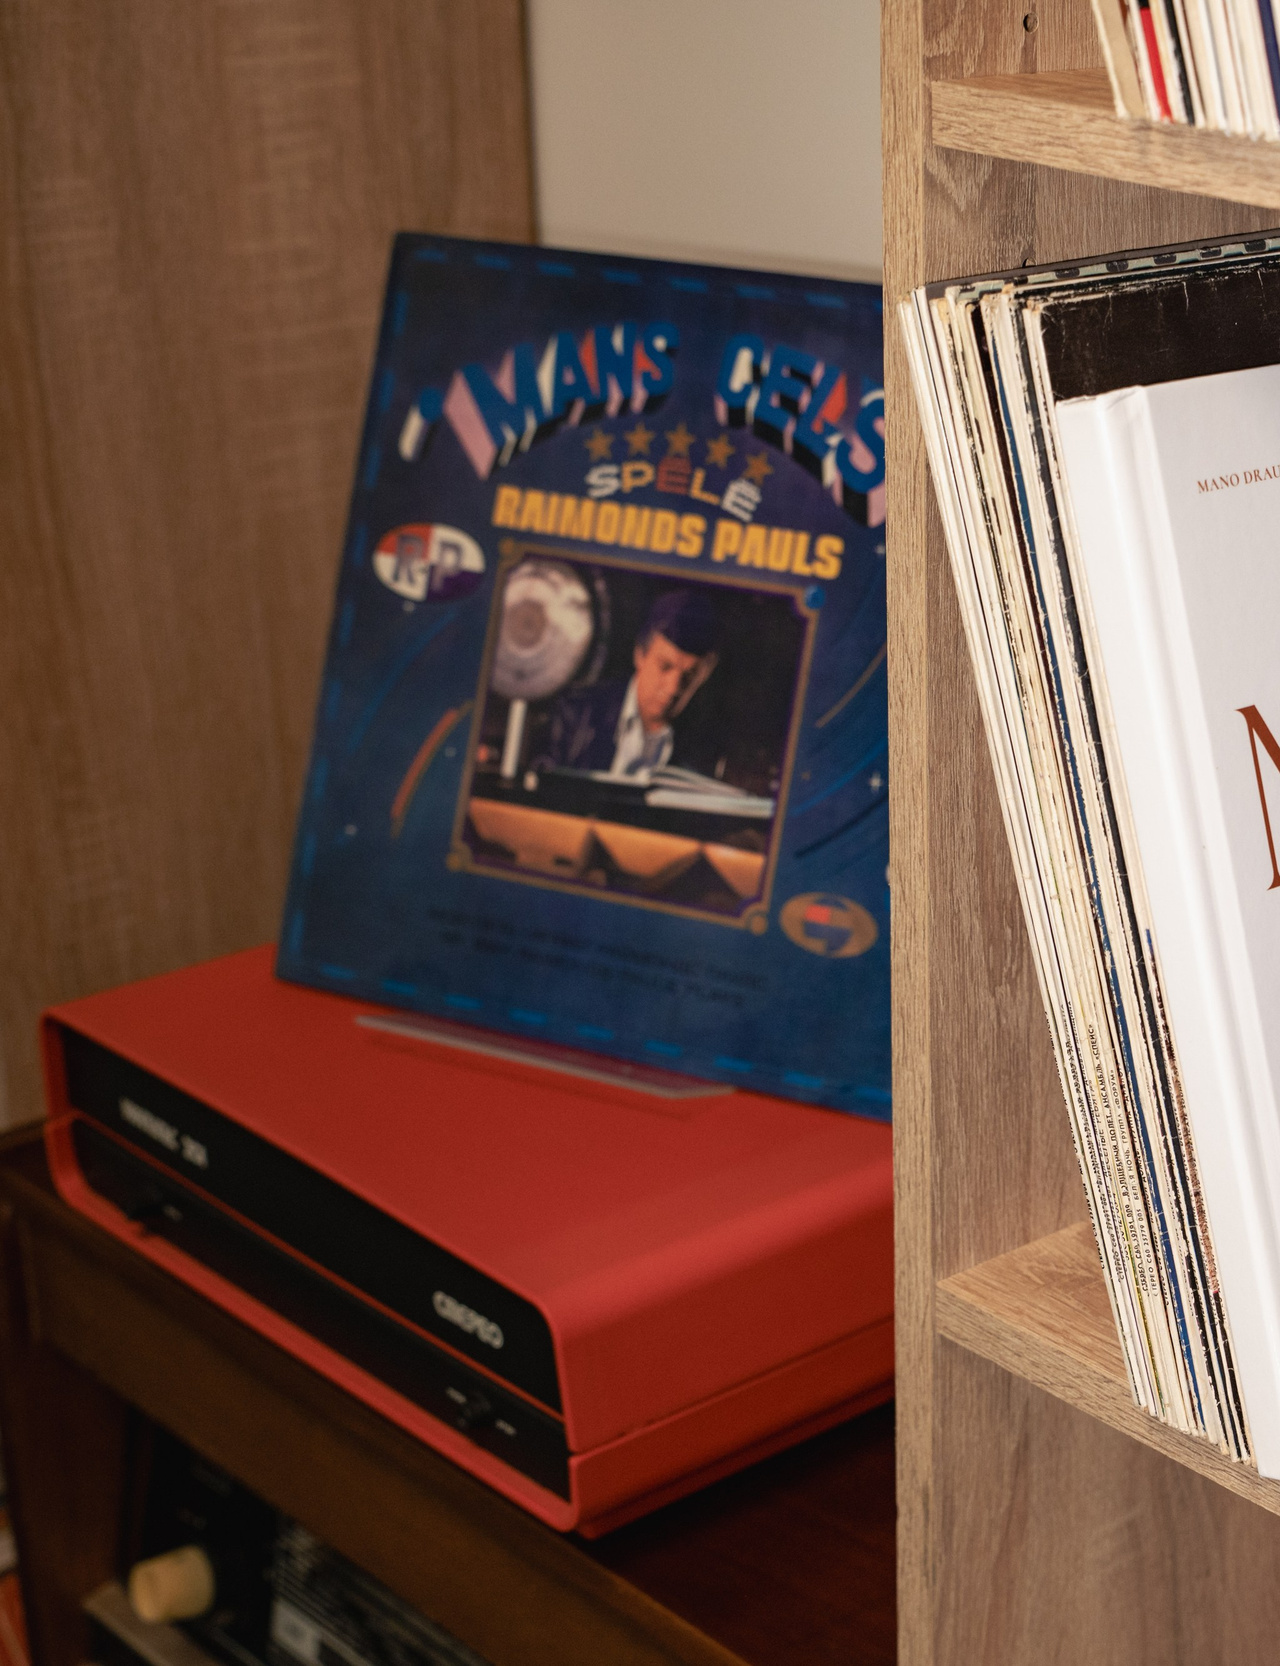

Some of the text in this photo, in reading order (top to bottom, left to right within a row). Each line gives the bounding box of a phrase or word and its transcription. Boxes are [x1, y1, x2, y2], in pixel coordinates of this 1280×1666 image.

[1197, 473, 1240, 494] MANO
[491, 484, 845, 580] RAIMONDS PAULS
[1108, 1068, 1120, 1109] «ФОРУМ»
